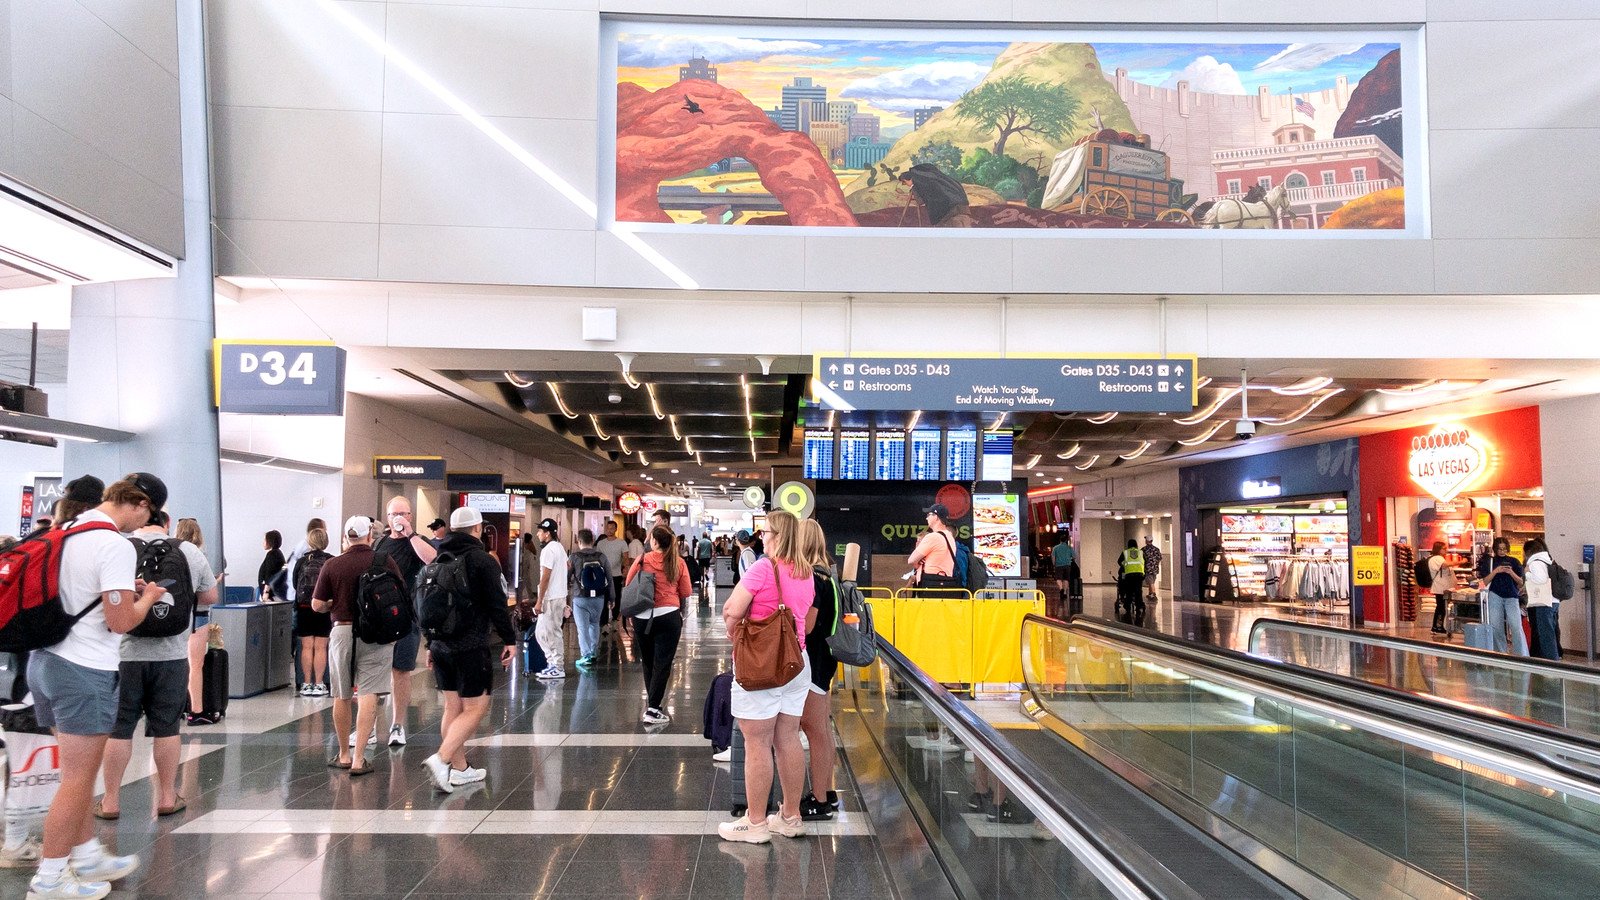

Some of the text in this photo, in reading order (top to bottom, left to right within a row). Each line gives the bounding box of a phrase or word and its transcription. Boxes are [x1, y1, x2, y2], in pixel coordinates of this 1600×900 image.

[240, 350, 317, 386] D34
[859, 364, 891, 376] Gates
[894, 364, 917, 376] D35
[926, 364, 951, 376] D43
[1060, 365, 1094, 376] Gates
[1096, 365, 1120, 376] D35
[1129, 365, 1154, 376] D43
[859, 380, 912, 391] Restrooms
[972, 385, 1039, 396] Watch Your Step
[1099, 381, 1153, 393] Restrooms
[956, 395, 1055, 407] End of Moving Walkway
[393, 464, 425, 474] Women
[1418, 458, 1470, 477] LAS VEGAS
[881, 523, 971, 541] QUIZS
[1357, 569, 1373, 580] 50
